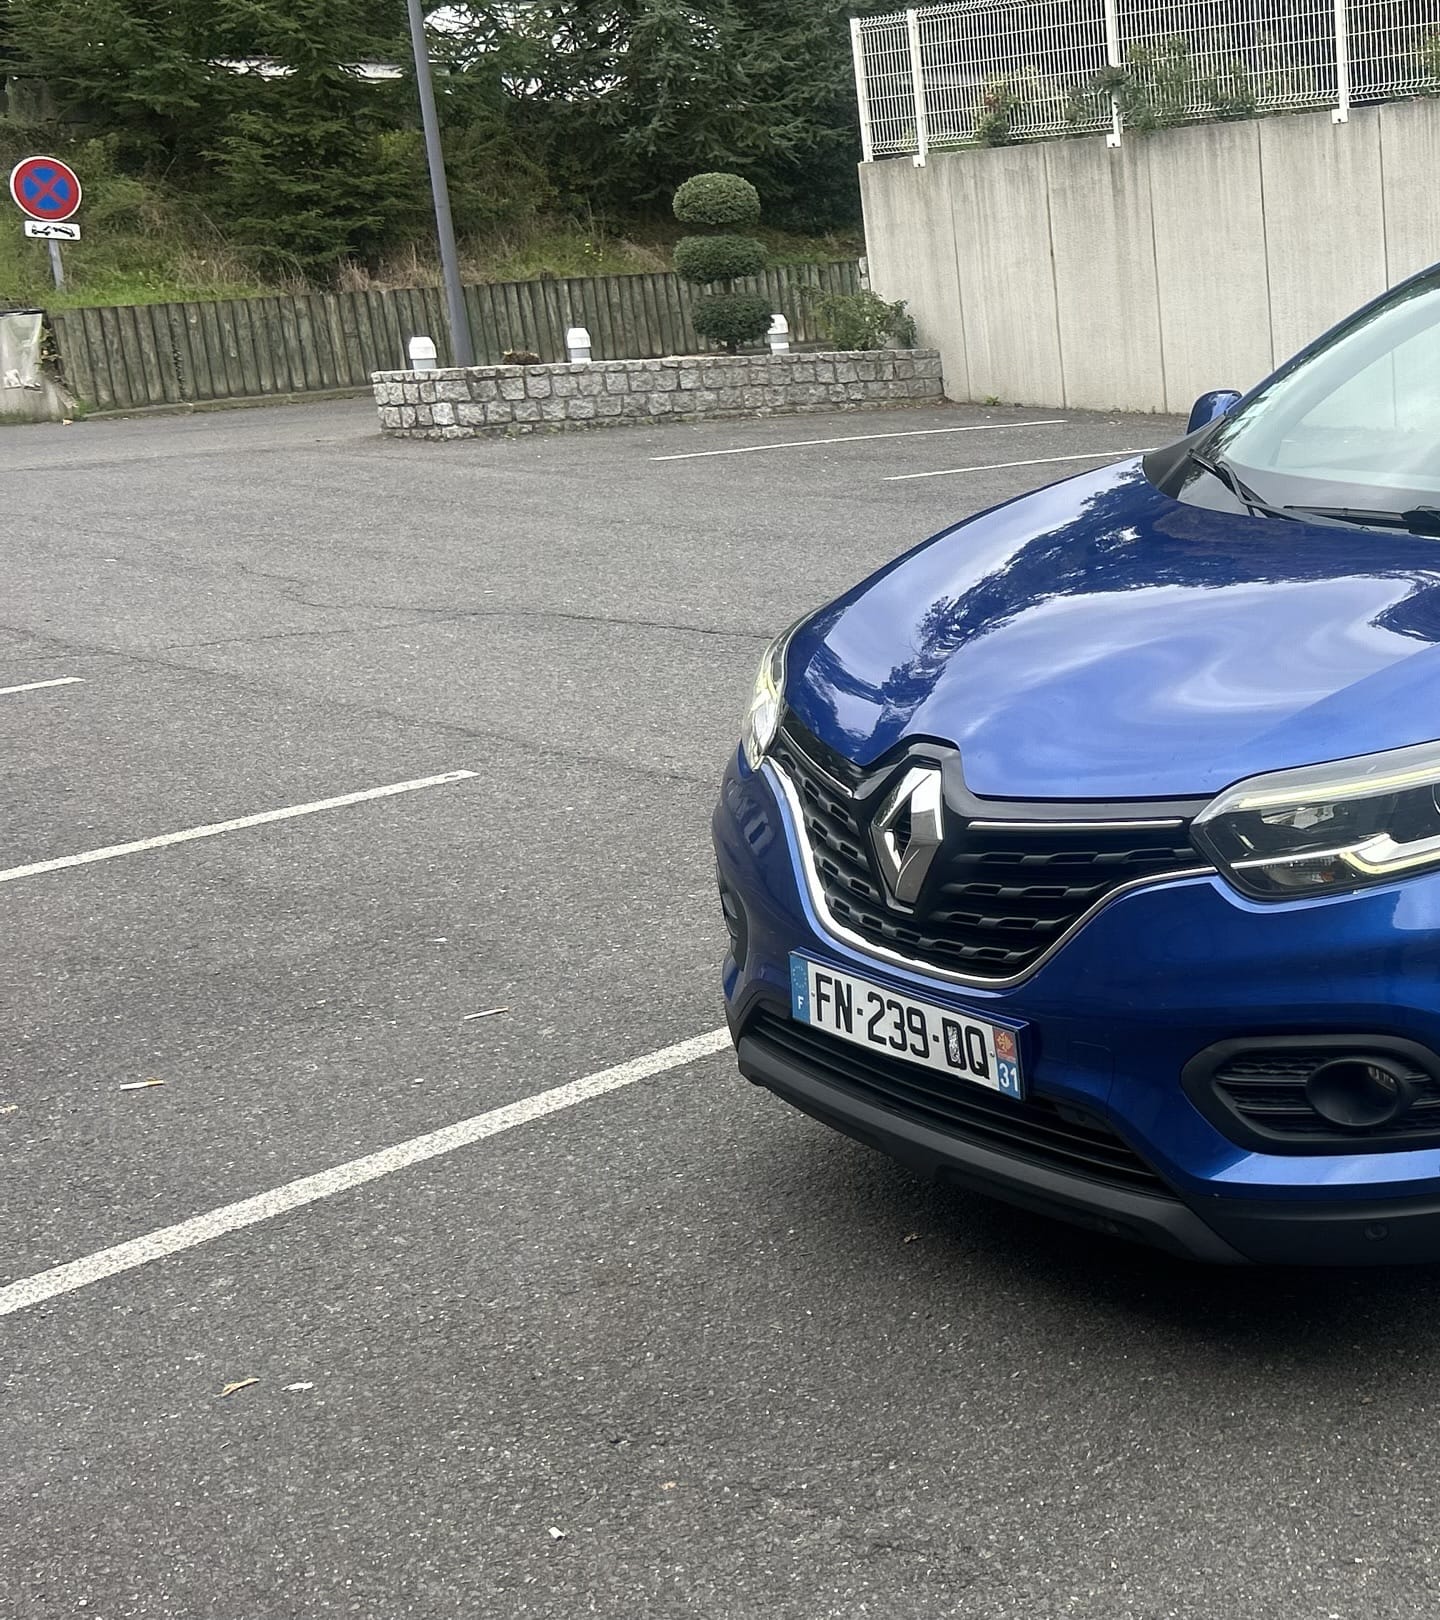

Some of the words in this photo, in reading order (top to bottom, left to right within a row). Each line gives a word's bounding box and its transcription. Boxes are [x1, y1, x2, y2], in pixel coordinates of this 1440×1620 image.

[797, 996, 804, 1010] F
[815, 972, 990, 1080] FN-239-DQ
[999, 1063, 1018, 1092] 31
